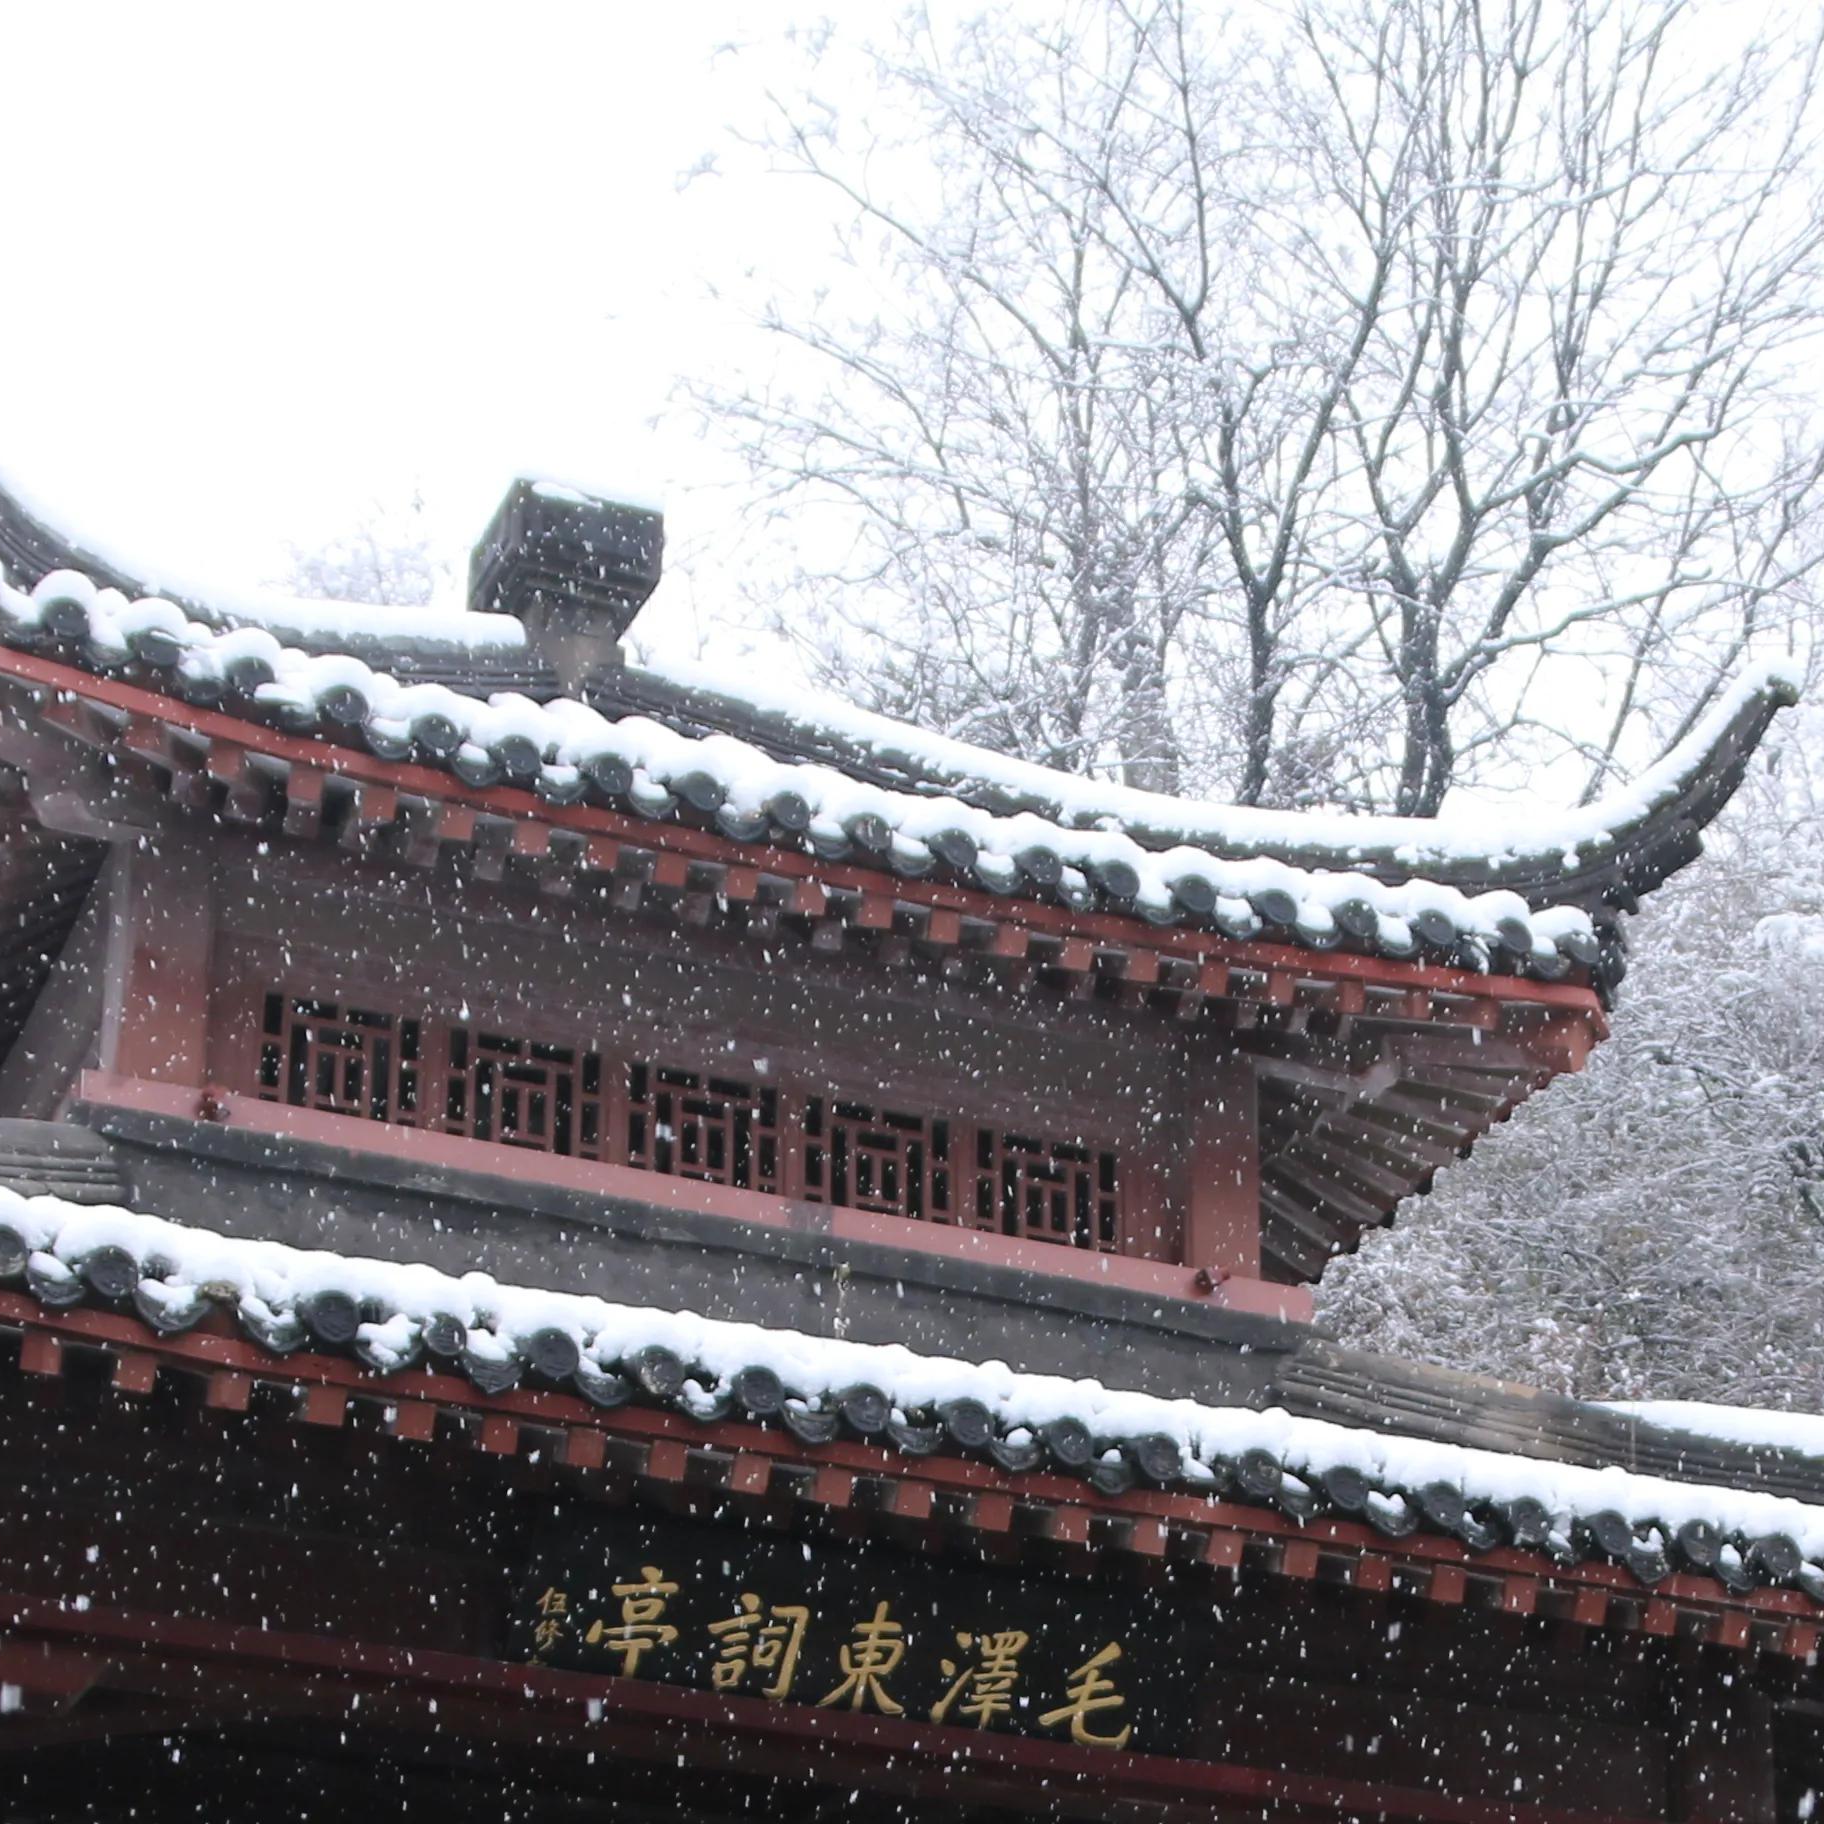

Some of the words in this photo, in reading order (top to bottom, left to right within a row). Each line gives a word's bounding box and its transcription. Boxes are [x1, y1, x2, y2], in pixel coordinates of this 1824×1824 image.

[526, 1586, 568, 1667] 伍修
[586, 1567, 1132, 1749] 毛澤東詞亭
